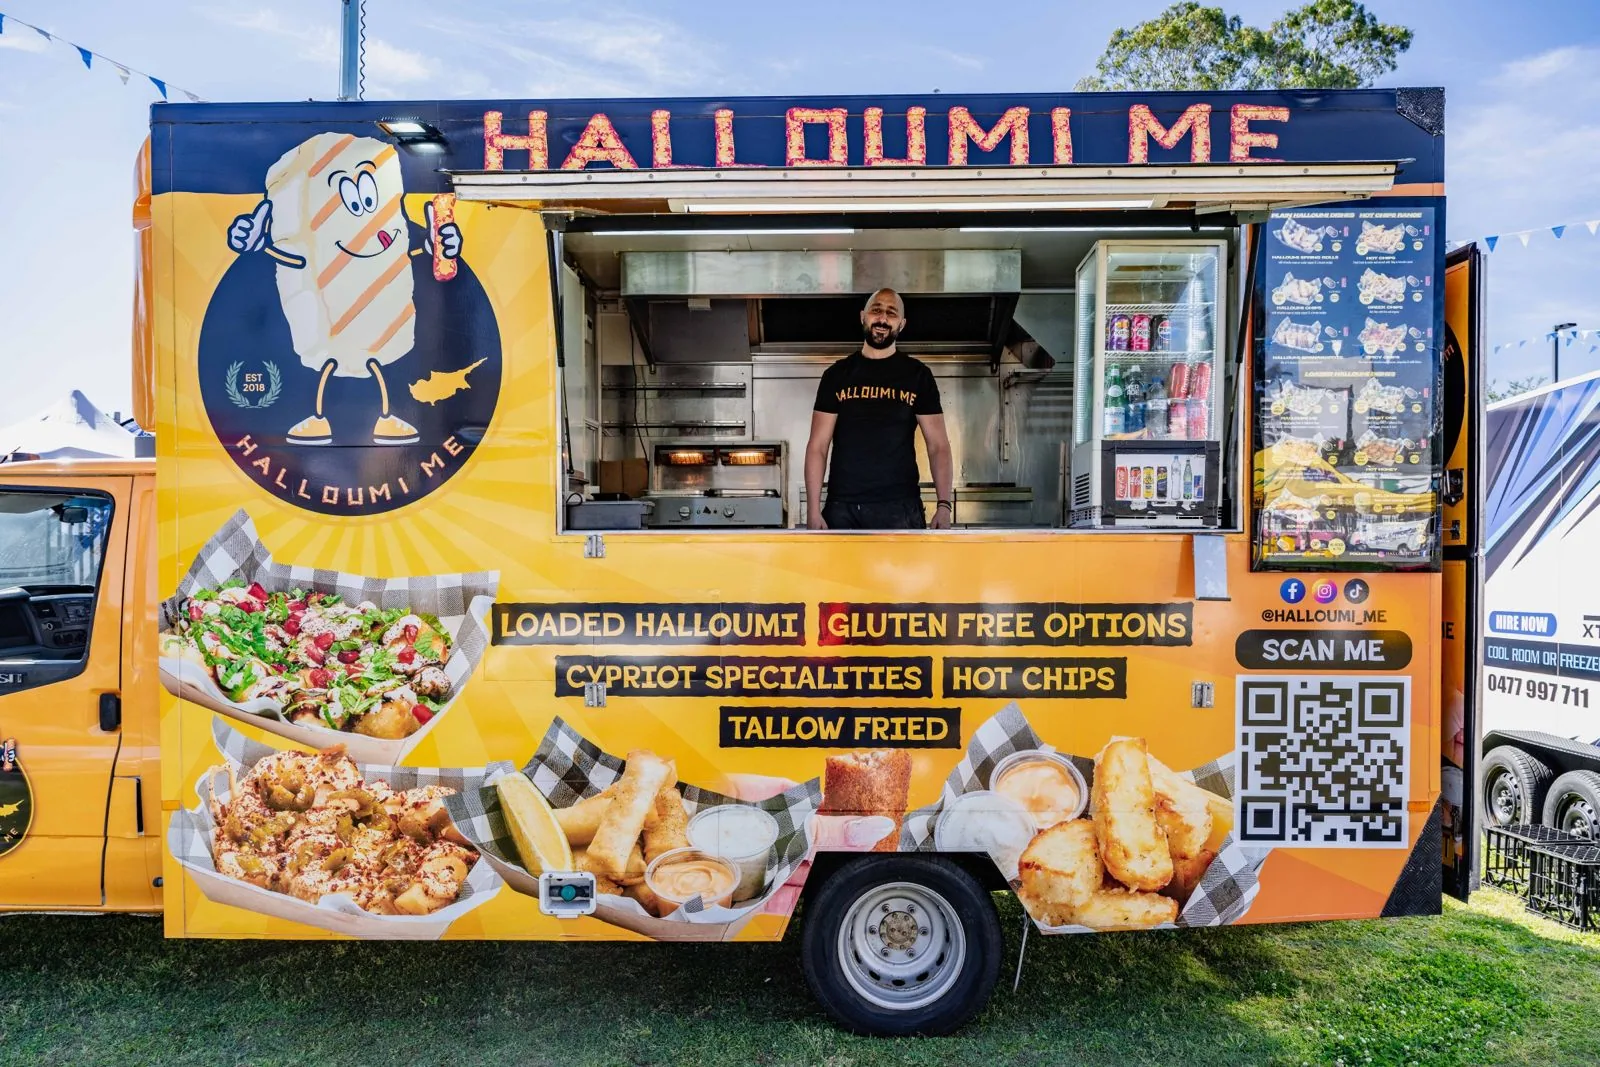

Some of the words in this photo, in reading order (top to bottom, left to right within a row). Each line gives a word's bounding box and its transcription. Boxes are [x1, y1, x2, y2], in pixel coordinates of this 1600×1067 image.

[484, 107, 1073, 170] HALLOUMI
[1129, 104, 1290, 163] ME
[243, 384, 265, 392] 2018
[245, 374, 262, 382] EST
[900, 390, 917, 406] ME
[236, 435, 409, 505] HALLOUMI
[420, 436, 464, 478] ME
[501, 612, 625, 638] LOADED
[635, 612, 798, 638] HALLOUMI
[827, 613, 947, 638] GLUTEN
[957, 613, 1035, 638] FREE
[1044, 613, 1187, 638] OPTIONS
[1262, 609, 1387, 625] @HALLOUMI_ME
[1495, 614, 1519, 630] HIRE
[1521, 616, 1548, 632] NOW
[1262, 639, 1334, 661] SCAN
[1344, 640, 1385, 661] ME
[1488, 645, 1509, 661] COOL
[1512, 648, 1540, 665] ROOM
[1542, 651, 1557, 667] OR
[1560, 653, 1600, 671] FREEZE
[566, 665, 696, 688] CYPRIOT
[705, 665, 922, 690] SPECIALITIES
[953, 667, 1012, 690] HOT
[1022, 667, 1115, 691] CHIPS
[1488, 673, 1522, 696] 0477
[1526, 679, 1558, 702] 997
[1561, 685, 1589, 708] 711
[728, 716, 845, 740] TALLOW
[854, 716, 948, 741] FRIED
[4, 827, 18, 843] ME
